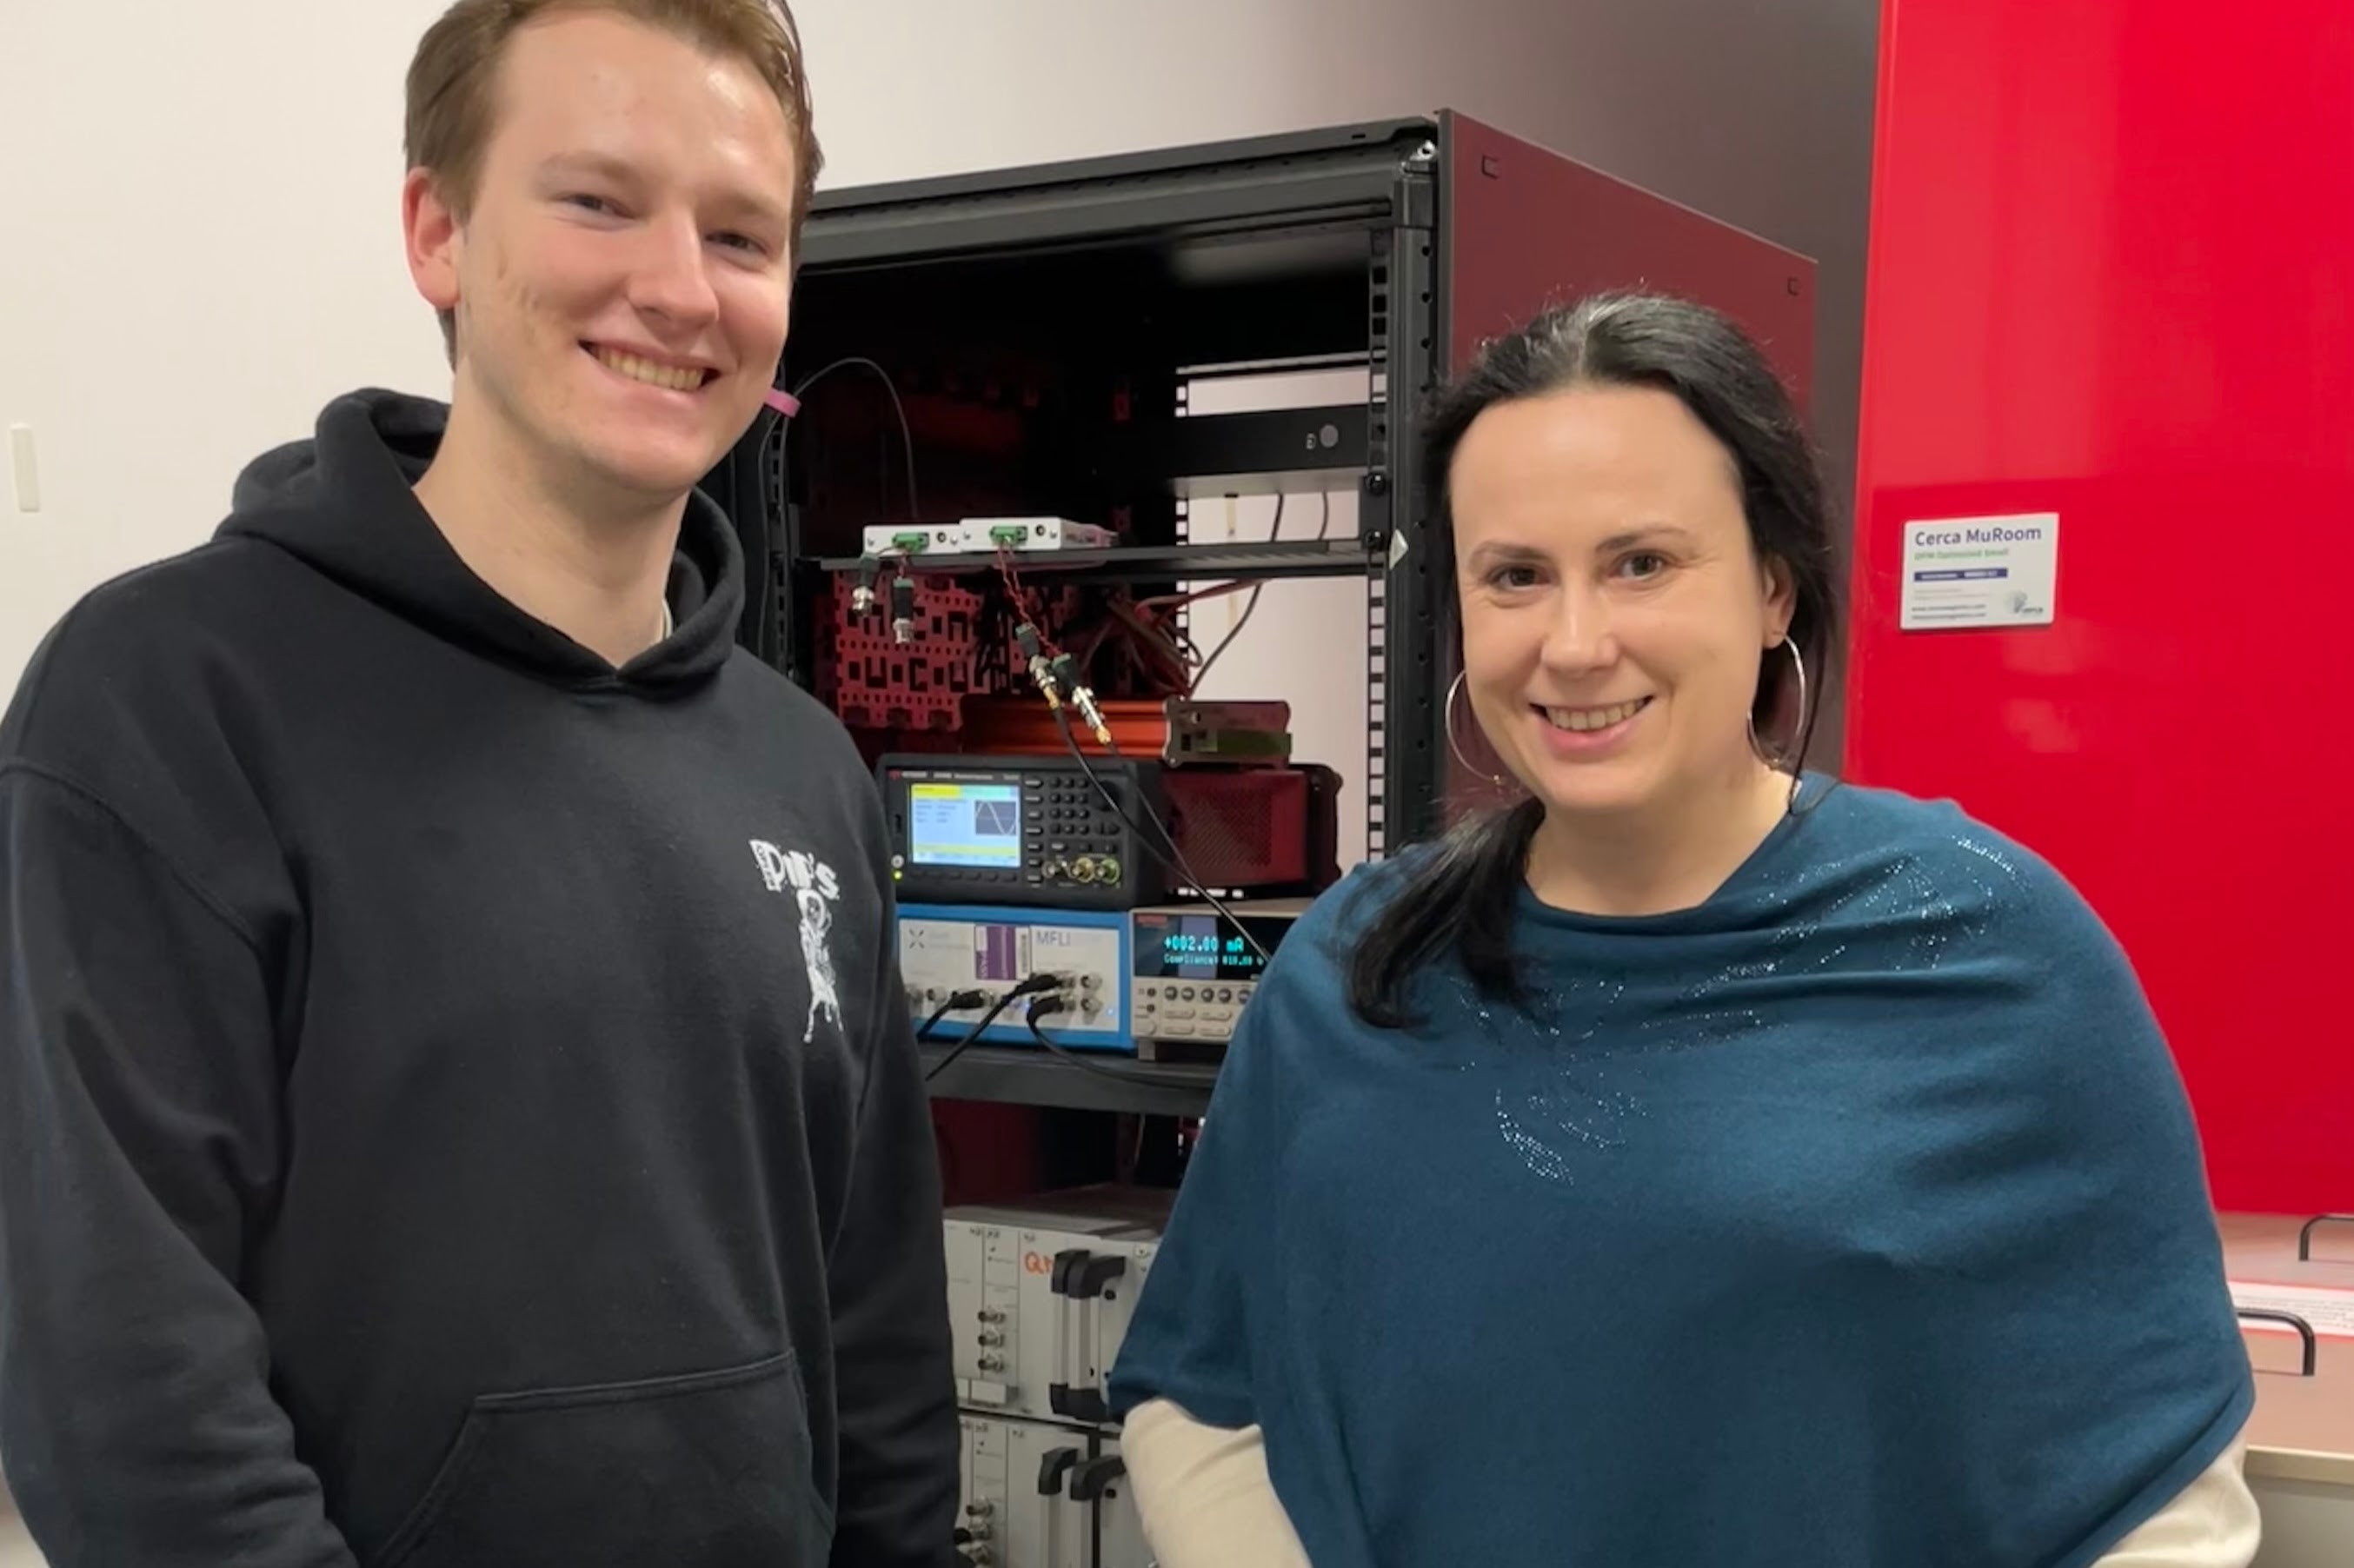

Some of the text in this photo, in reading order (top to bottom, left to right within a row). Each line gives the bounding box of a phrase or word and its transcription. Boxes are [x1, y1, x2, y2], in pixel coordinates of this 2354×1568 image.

[1915, 527, 2042, 546] Cerca MuRoom
[1036, 931, 1071, 947] MFLI
[1164, 934, 1245, 953] +002.00 mA
